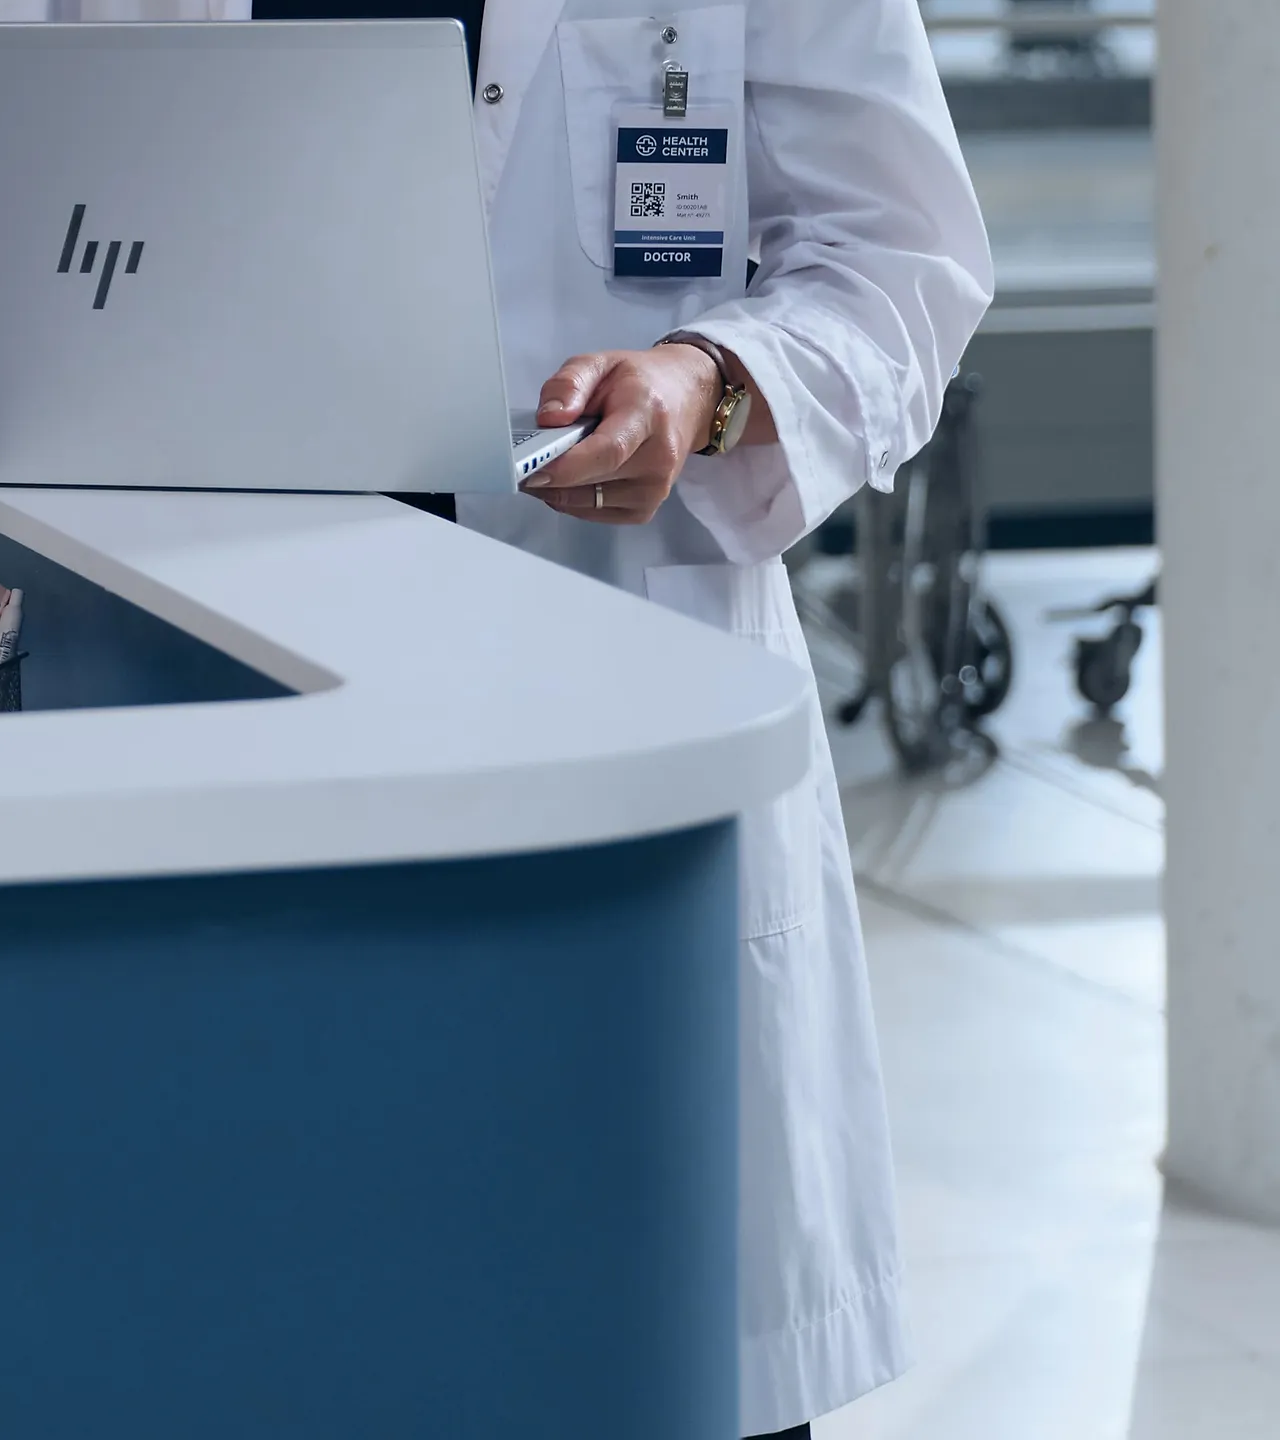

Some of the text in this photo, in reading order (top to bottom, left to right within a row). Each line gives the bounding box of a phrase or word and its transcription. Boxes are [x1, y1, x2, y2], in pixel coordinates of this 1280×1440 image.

[663, 136, 708, 146] HEALTH
[662, 147, 709, 157] CENTER
[676, 193, 699, 201] Smith
[56, 203, 145, 310] hp
[643, 252, 691, 262] DOCTOR
